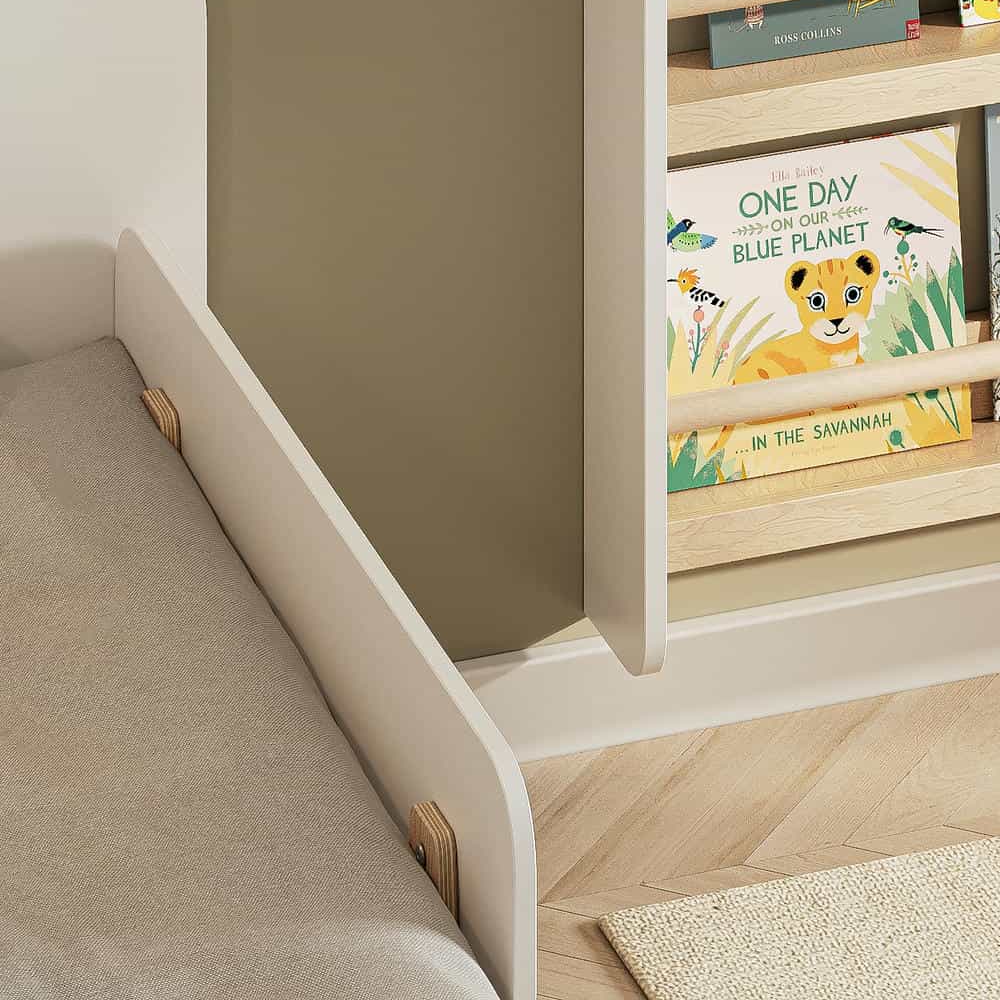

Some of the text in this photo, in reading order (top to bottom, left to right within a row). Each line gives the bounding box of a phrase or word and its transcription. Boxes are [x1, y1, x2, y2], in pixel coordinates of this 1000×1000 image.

[774, 26, 843, 46] ROSS COLLINS
[739, 174, 858, 219] ONE DAY
[770, 210, 830, 232] ON OUR
[733, 221, 870, 264] BLUE PLANET
[774, 427, 805, 447] THE
[813, 411, 892, 440] SAVANNAH
